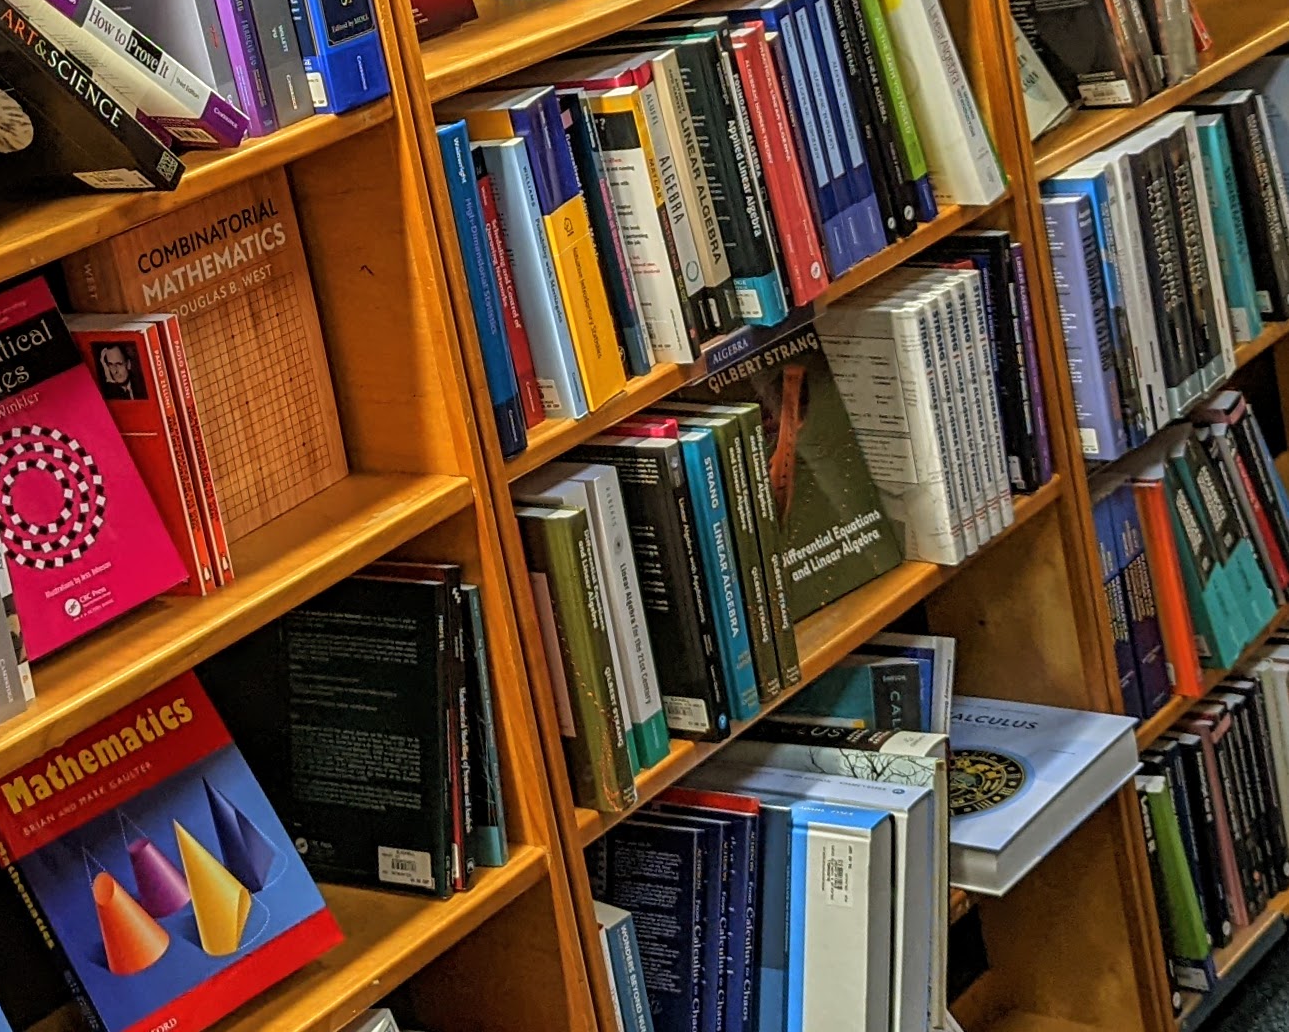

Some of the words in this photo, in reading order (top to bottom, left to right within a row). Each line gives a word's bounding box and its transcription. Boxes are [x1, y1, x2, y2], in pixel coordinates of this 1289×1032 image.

[0, 7, 37, 46] ART
[34, 38, 49, 58] &
[47, 50, 124, 128] SCIENCE
[87, 7, 117, 36] How
[113, 28, 128, 46] to
[127, 34, 162, 73] Prove
[156, 62, 171, 79] It
[727, 120, 745, 161] Applied
[659, 155, 687, 225] ALGEBRA
[680, 117, 702, 181] LINEAR
[696, 185, 723, 265] ALGEBRA
[737, 155, 755, 195] Linear
[138, 198, 279, 274] COMBINATORIAL
[745, 194, 762, 237] Algebra
[141, 222, 286, 307] MATHEMATICS
[707, 361, 762, 395] GILBERT
[764, 331, 819, 368] STRANG
[711, 338, 749, 366] ALGEBRA
[703, 456, 720, 510] STRANG
[791, 563, 811, 582] and
[810, 552, 843, 572] Linear
[842, 528, 881, 555] Algebra
[833, 509, 882, 540] Equations
[712, 521, 728, 576] LINEAR
[721, 572, 739, 639] ALGEBRA
[950, 711, 1039, 730] ALCULUS
[0, 693, 195, 817] Mathematics
